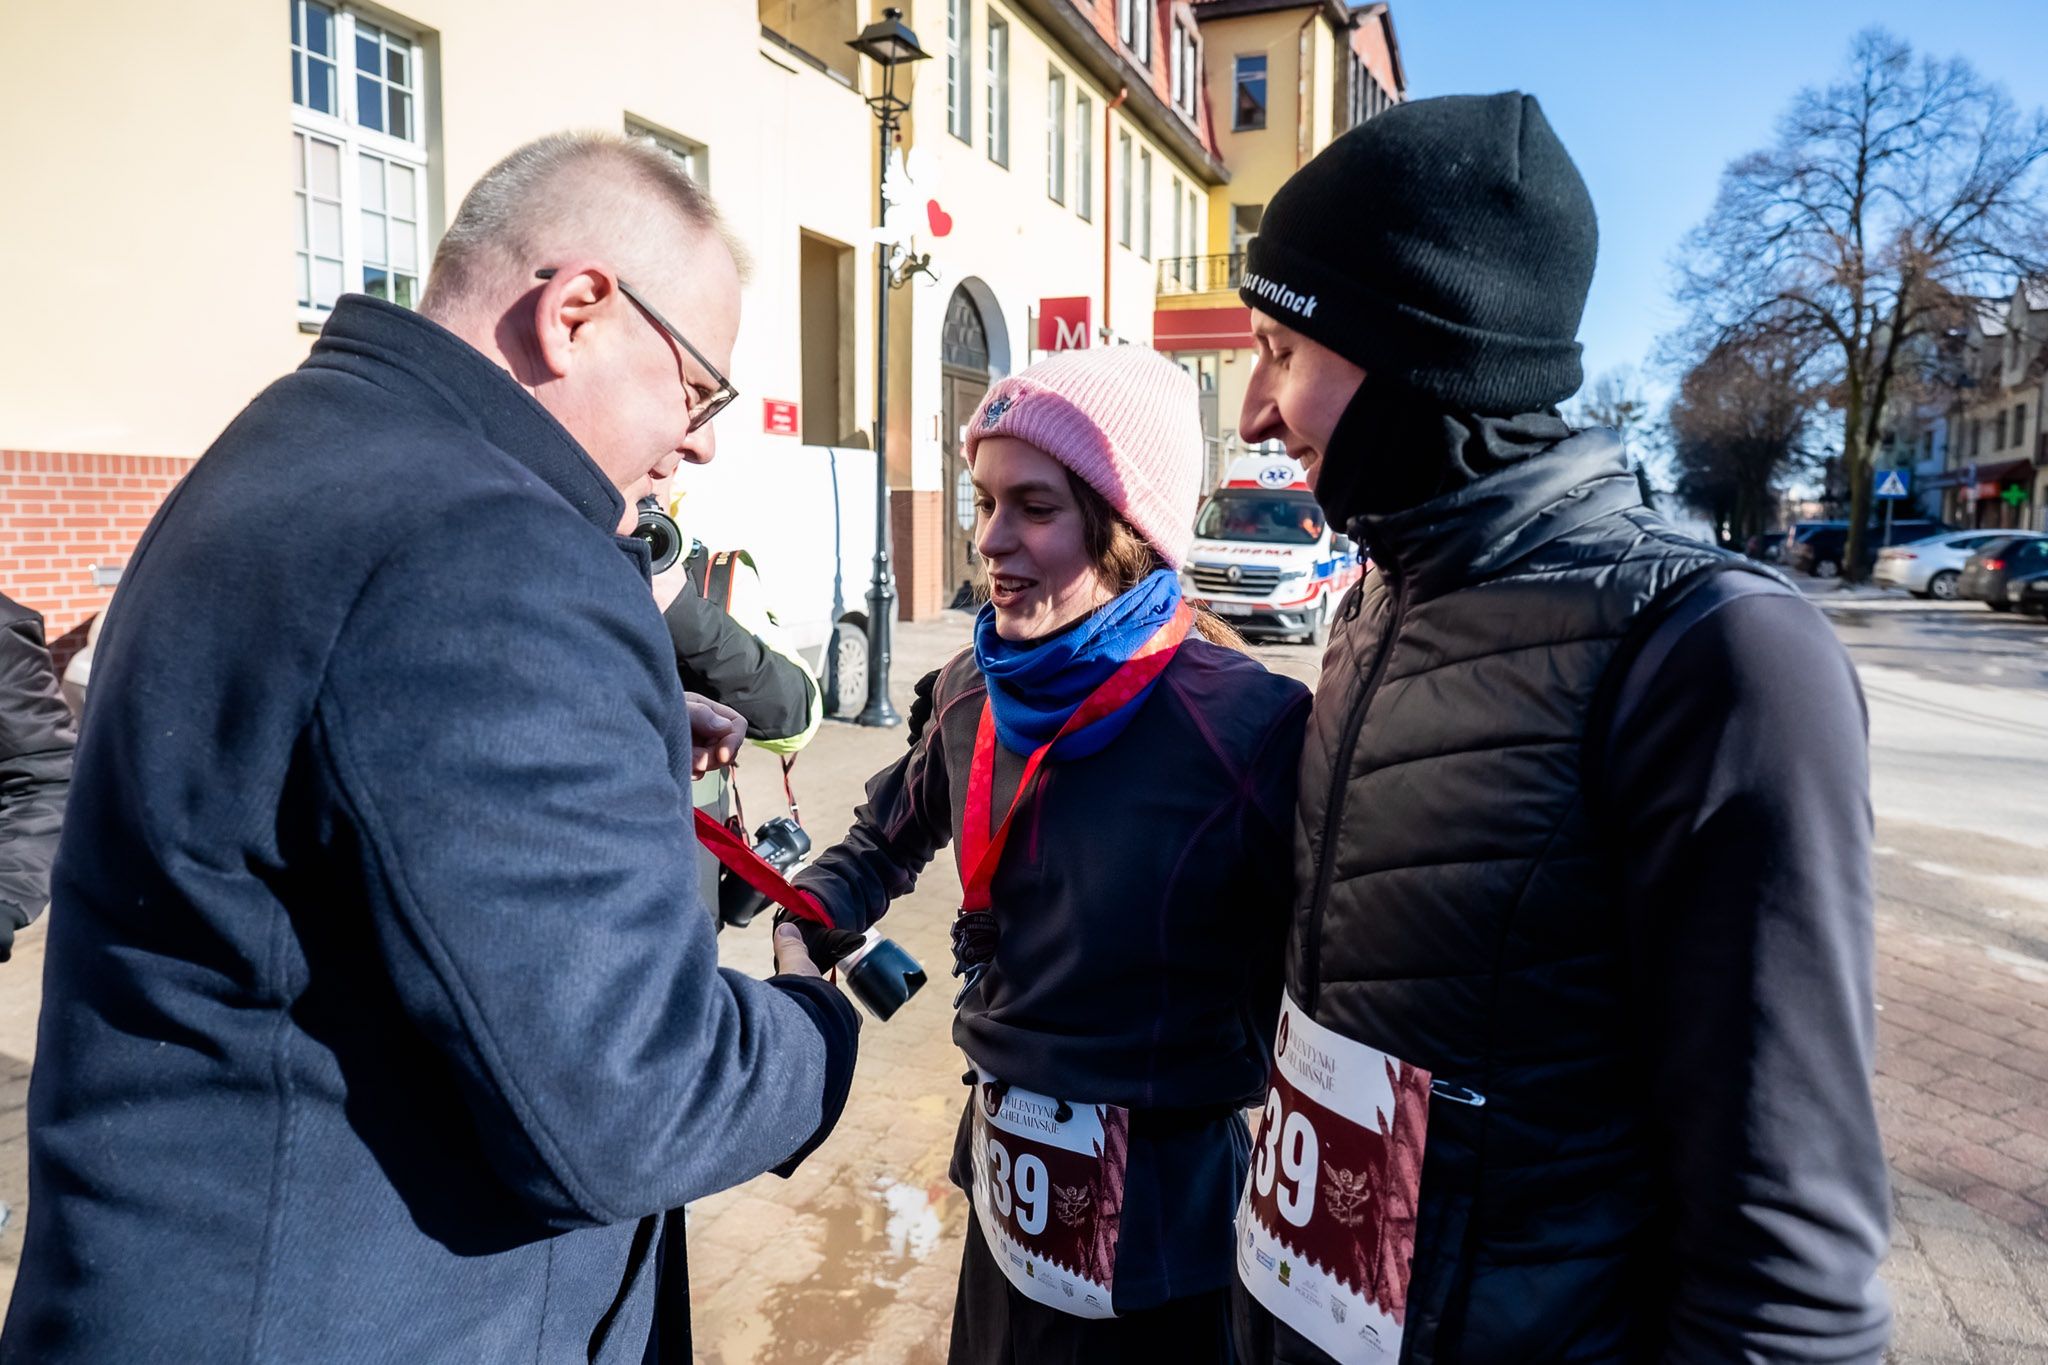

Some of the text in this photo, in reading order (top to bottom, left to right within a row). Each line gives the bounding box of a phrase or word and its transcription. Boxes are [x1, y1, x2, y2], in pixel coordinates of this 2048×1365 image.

[1053, 315, 1087, 351] M
[989, 1138, 1049, 1236] 39
[1255, 1087, 1319, 1228] 39
